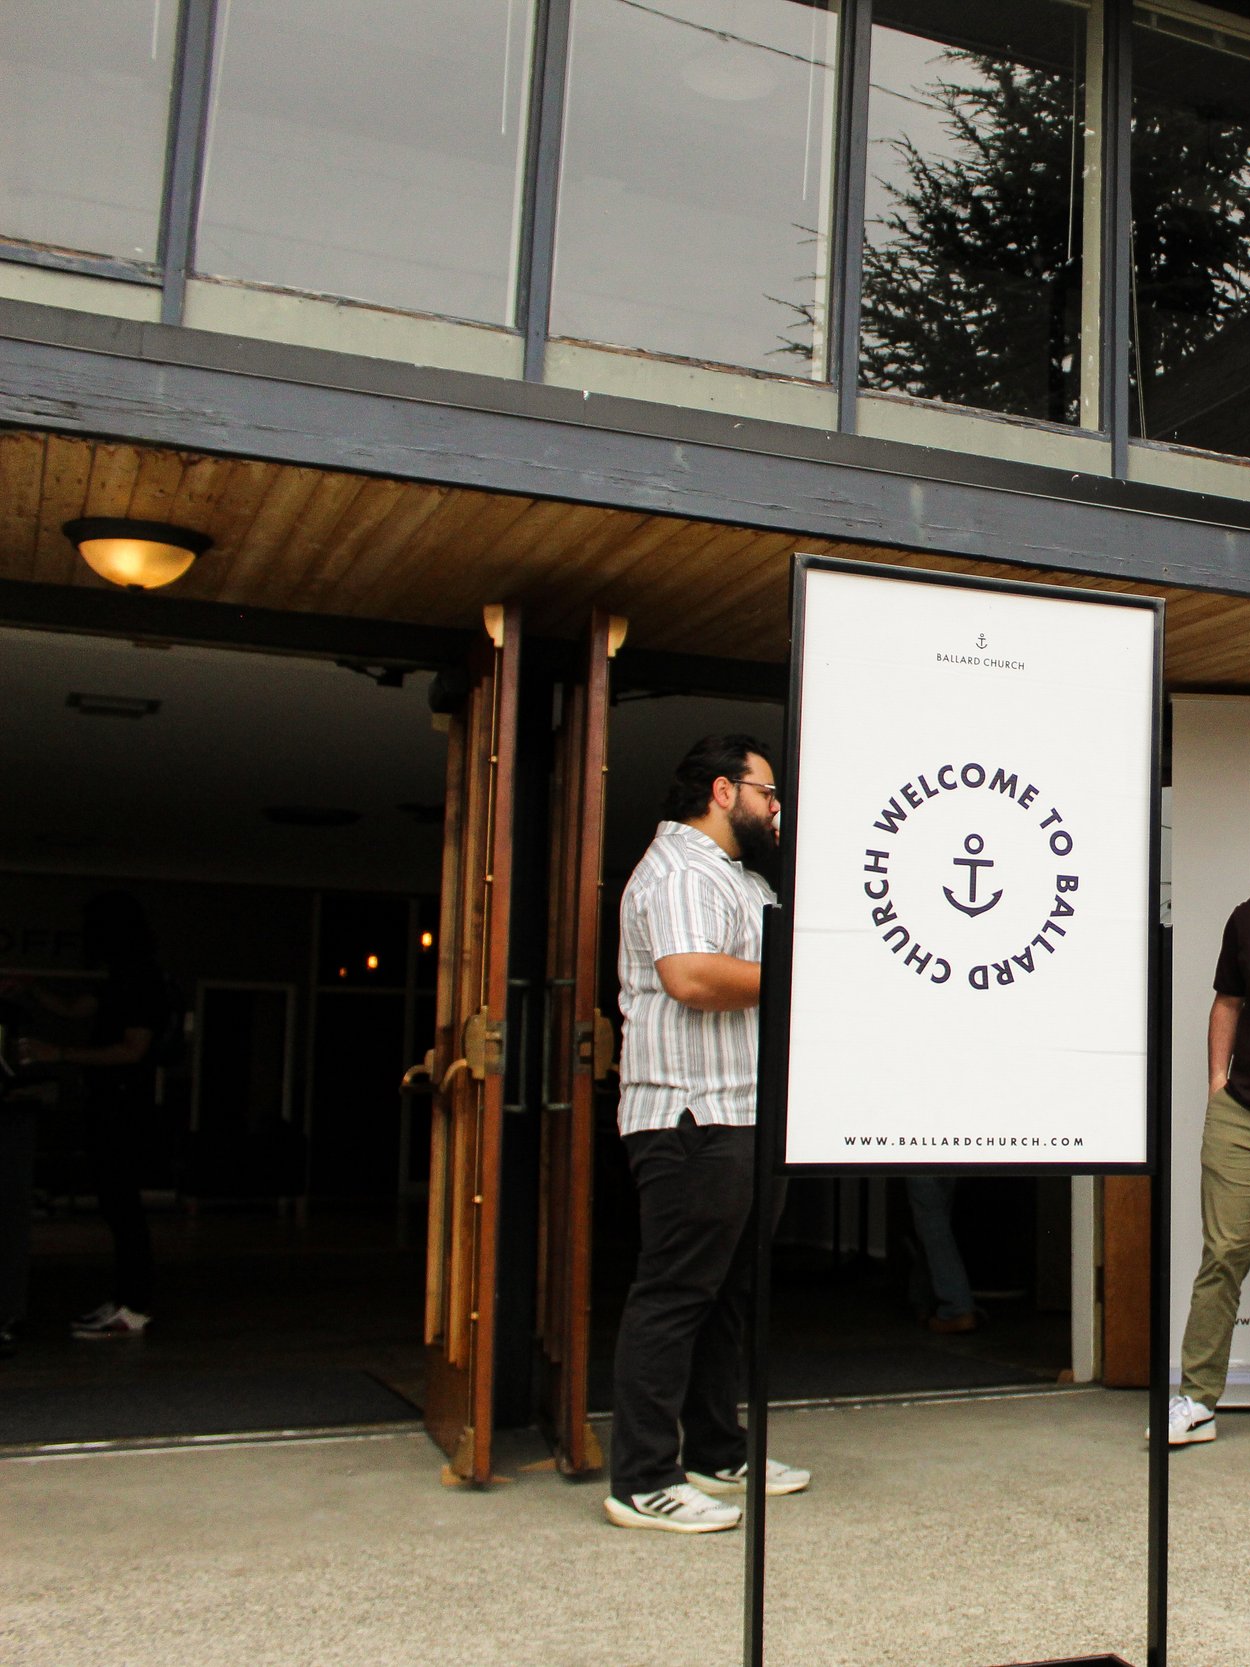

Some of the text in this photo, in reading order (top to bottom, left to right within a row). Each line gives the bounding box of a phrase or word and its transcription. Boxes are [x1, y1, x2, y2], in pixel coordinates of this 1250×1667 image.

[936, 653, 1025, 670] BALLARD CHURCH
[863, 762, 1080, 990] WELCOME TO BALLARD CHURCH
[844, 1136, 1085, 1147] WWW.BALLARDCHURCH.COM
